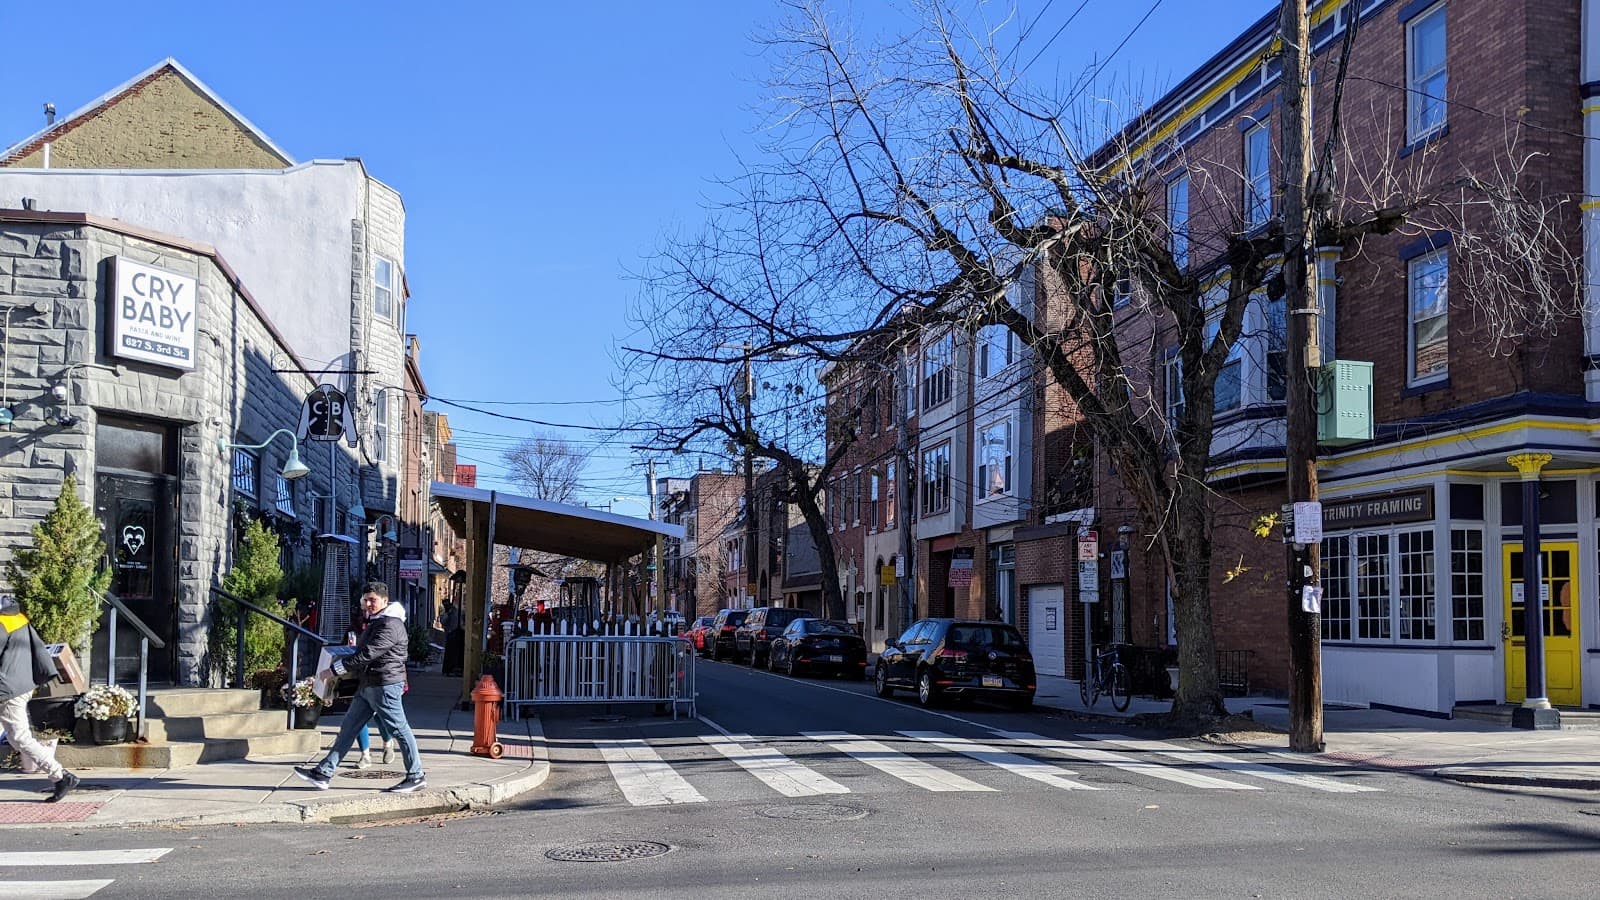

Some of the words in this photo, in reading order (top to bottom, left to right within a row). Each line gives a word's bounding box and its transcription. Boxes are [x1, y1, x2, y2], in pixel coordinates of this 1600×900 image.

[132, 273, 184, 304] CRY
[123, 296, 191, 332] BABY
[130, 326, 149, 335] PASTA
[150, 330, 163, 338] AND
[164, 334, 181, 342] WINE
[125, 338, 143, 348] 627
[144, 341, 154, 351] S.
[156, 345, 171, 354] 3rd
[172, 348, 186, 357] St.
[312, 401, 323, 415] C
[331, 401, 342, 416] B
[1323, 504, 1363, 521] TRINITY
[1367, 497, 1422, 517] FRAMING
